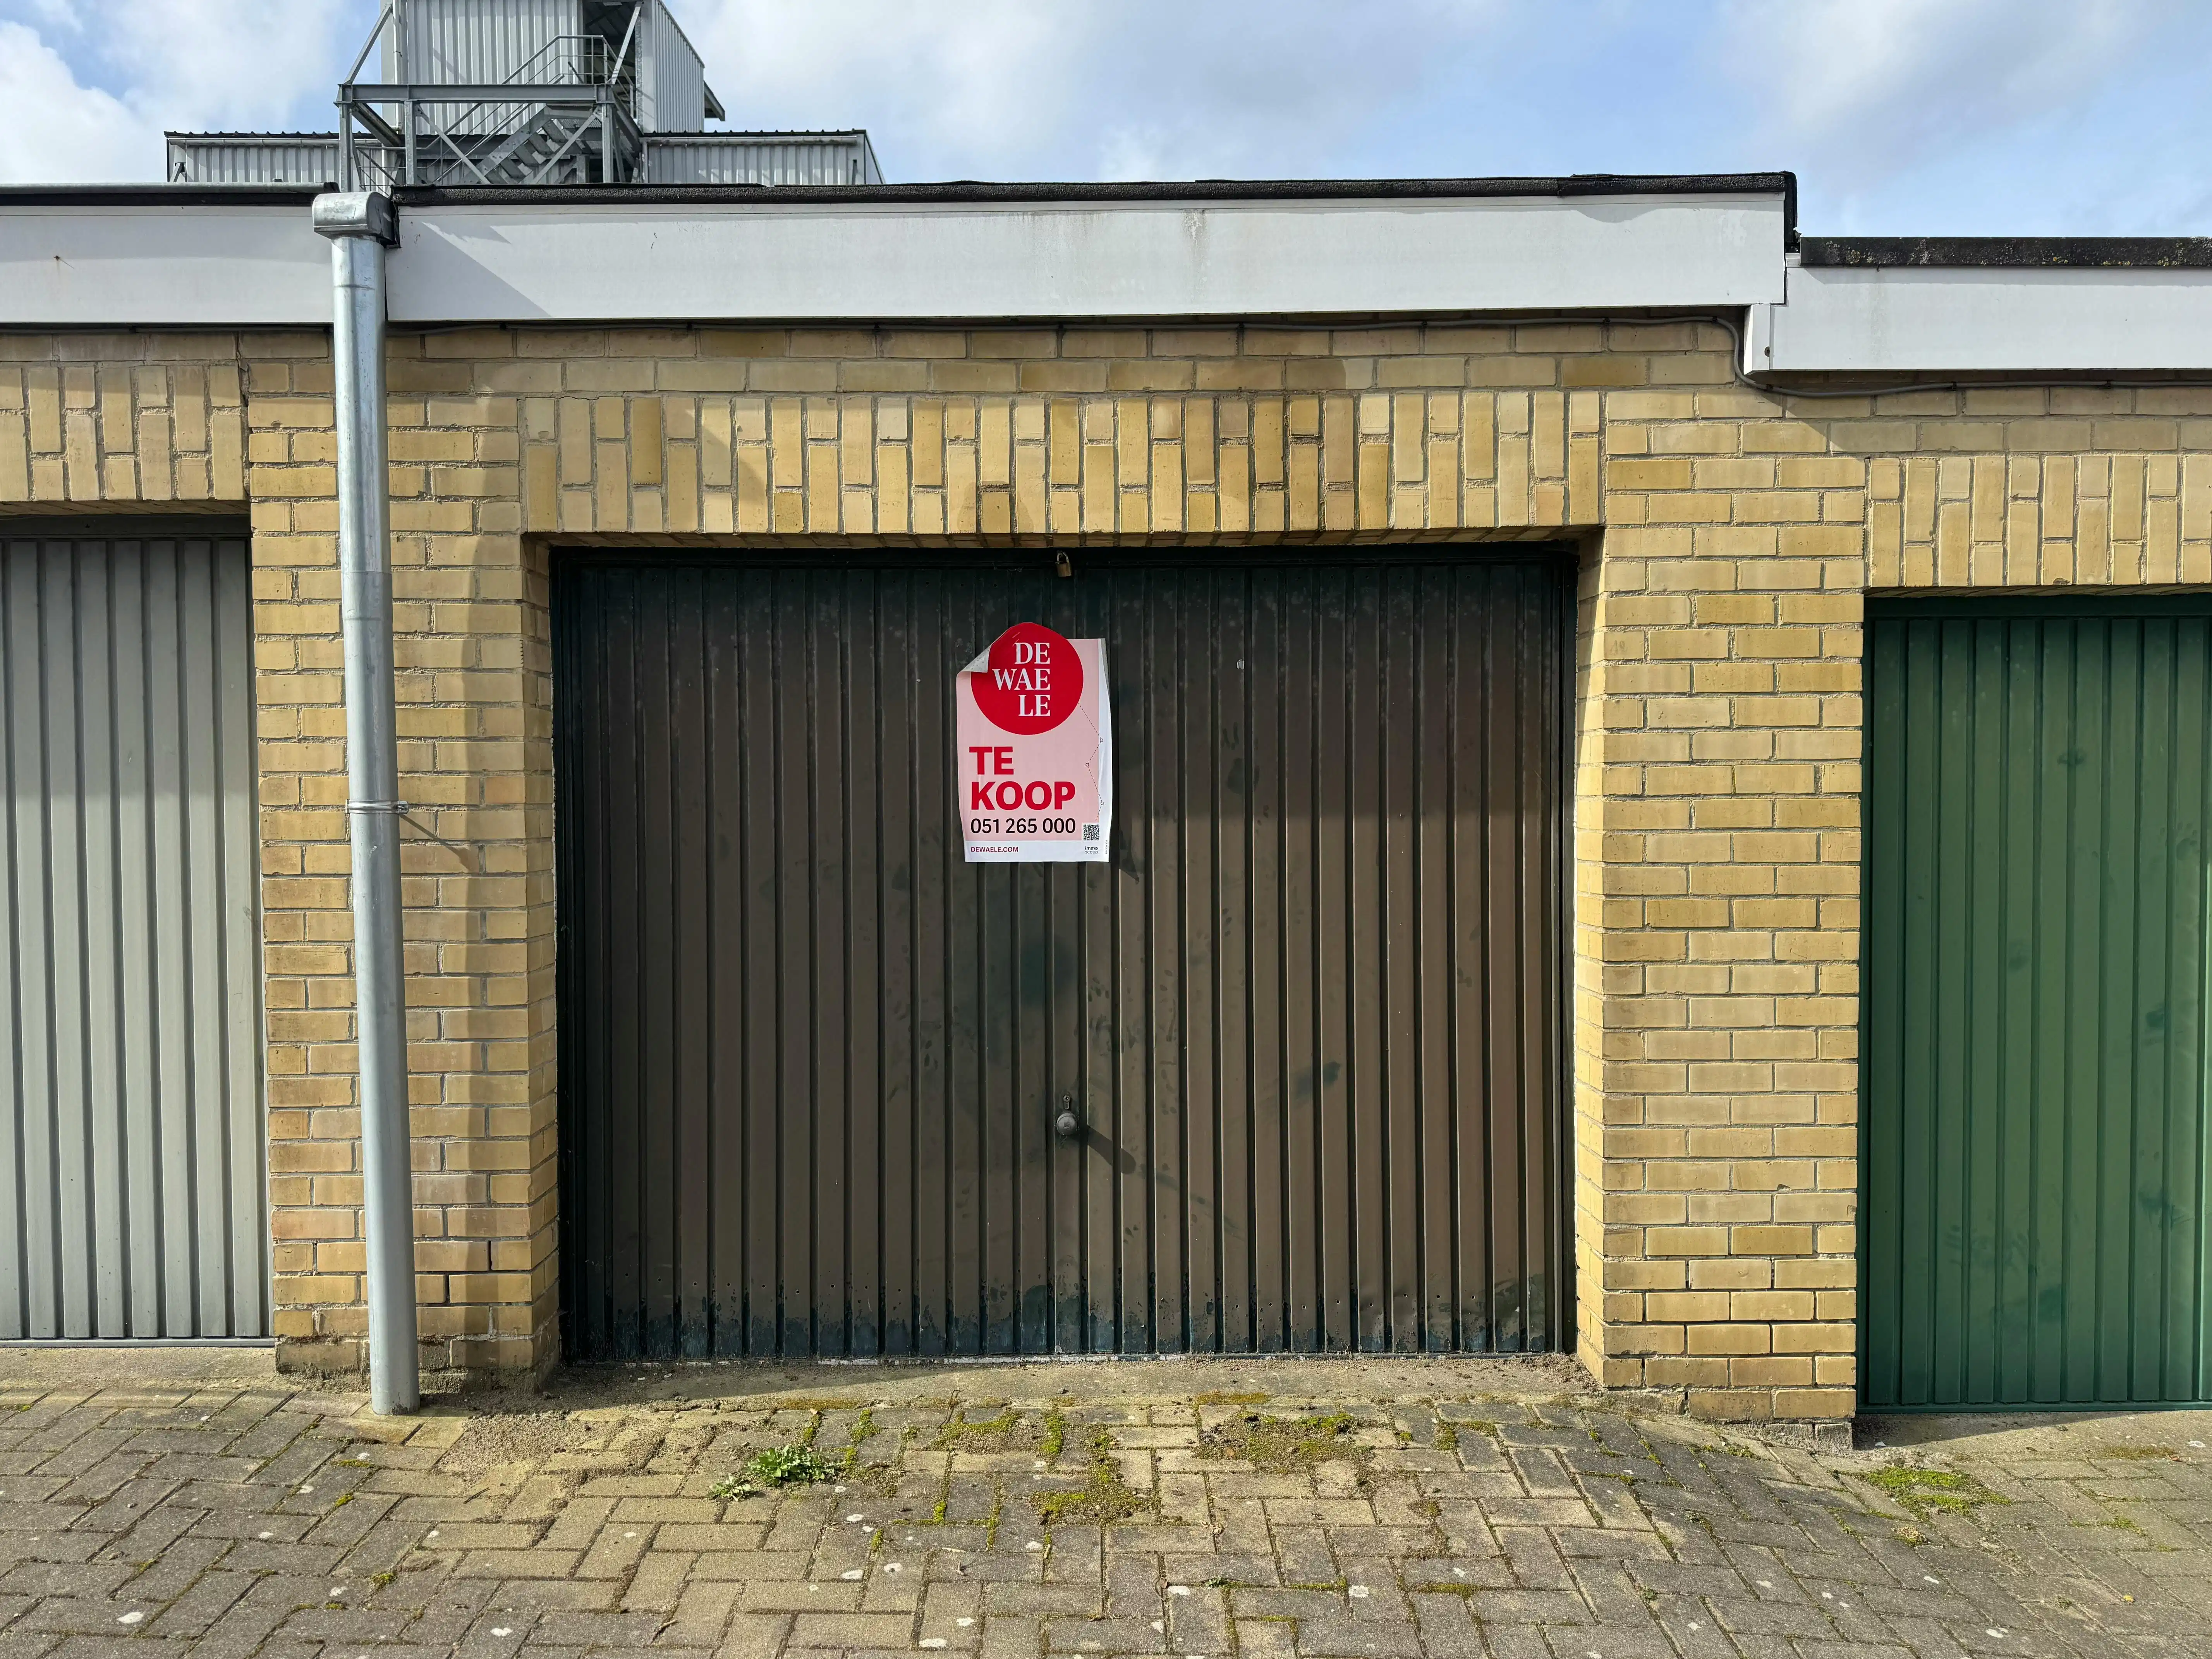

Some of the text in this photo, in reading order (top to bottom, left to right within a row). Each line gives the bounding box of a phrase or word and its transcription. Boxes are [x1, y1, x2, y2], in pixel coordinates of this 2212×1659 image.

[1014, 642, 1050, 664] DE
[992, 668, 1050, 690] WAE
[1018, 694, 1050, 716] LE
[969, 746, 1014, 775] TE
[971, 781, 1075, 810] KOOP
[971, 818, 1075, 833] 051 265 000
